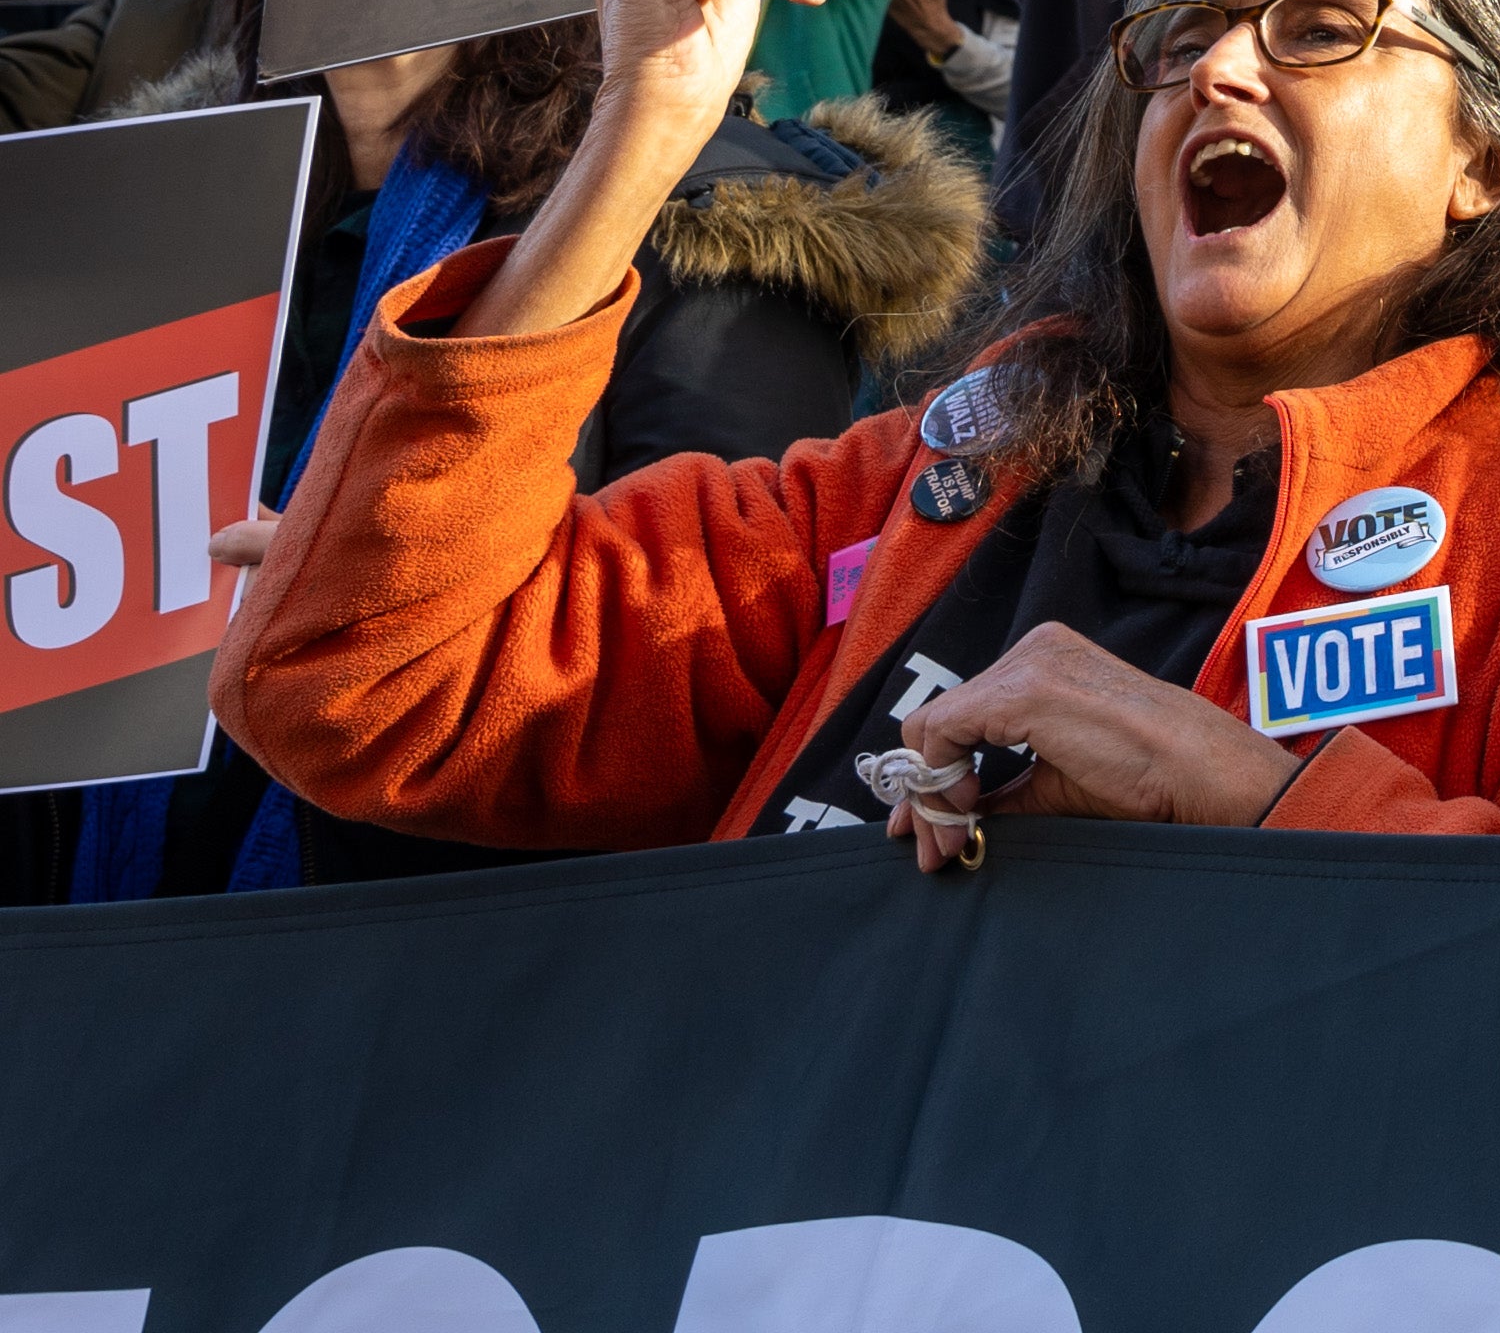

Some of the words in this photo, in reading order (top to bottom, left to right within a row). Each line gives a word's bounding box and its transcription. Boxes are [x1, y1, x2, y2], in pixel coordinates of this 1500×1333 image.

[945, 389, 977, 445] WALZ
[923, 466, 953, 518] TRAITOR
[950, 462, 976, 501] TRUMP
[1318, 501, 1428, 551] VOTE
[1333, 525, 1411, 565] RESPONSIBLY
[1273, 616, 1426, 710] VOTE
